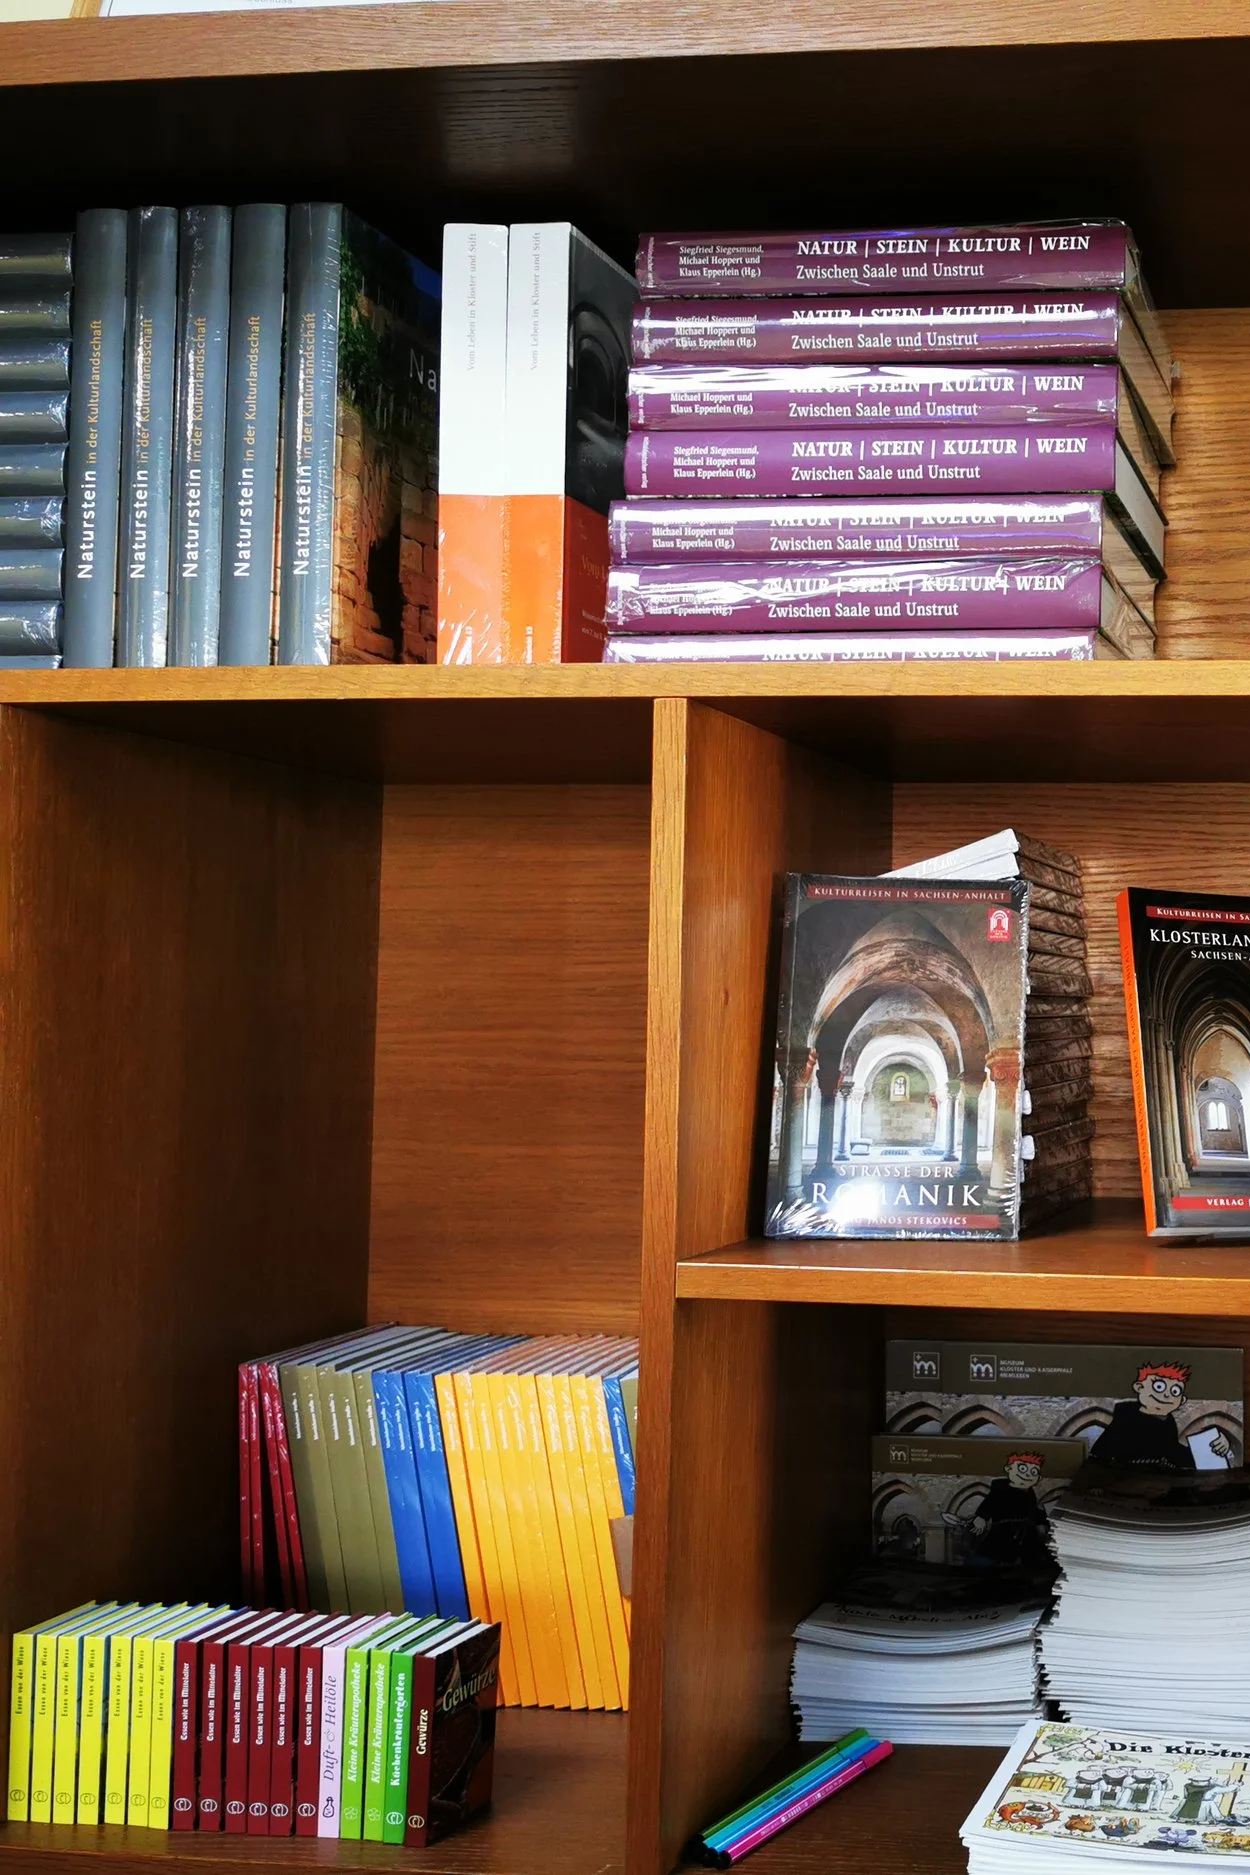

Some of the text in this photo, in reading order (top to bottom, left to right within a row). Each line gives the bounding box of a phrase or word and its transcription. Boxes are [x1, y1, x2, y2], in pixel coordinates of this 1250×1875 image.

[679, 245, 764, 255] Siegfried Siegesmund,
[797, 236, 1091, 255] NATUR STEIN KULTUR WEIN
[679, 255, 761, 266] Michael Hoppert und
[796, 262, 985, 279] Zwischen Saale und Unstrut
[679, 267, 761, 279] Klaus Epperlein (Hg.)
[466, 232, 477, 371] Vom Leben in Kloster und Stift
[303, 313, 316, 418] Kulturlandschaft
[302, 423, 313, 444] der
[78, 320, 102, 579] Naturstein in der Kulturlandschaft
[130, 319, 152, 578] Naturstein in der Kulturlandschaft
[183, 317, 207, 577] Naturstein in der Kulturlandschaft
[234, 316, 260, 577] Naturstein in der Kulturlandschaft
[673, 446, 709, 456] Siegfried
[791, 437, 1087, 457] NATUR STEIN KULTUR WEIN
[673, 457, 756, 468] Michael Hoppert und
[791, 464, 980, 481] Zwischen Saale und Unstrut
[673, 468, 756, 480] Klaus Epperlein (Hg.)
[293, 465, 311, 575] Naturstein
[814, 887, 891, 898] KULTURREISEN
[913, 891, 1006, 900] SACHSEN-ANHALT
[1156, 907, 1221, 920] KULTURREISEN
[1225, 912, 1235, 920] IN
[839, 1165, 954, 1178] STRASSE DER
[1206, 1198, 1244, 1206] VERLAG
[906, 1216, 968, 1226] STEKOVICS
[15, 1646, 25, 1715] Essen von der Wiese
[442, 1669, 495, 1712] Gewürze
[180, 1662, 190, 1741] Essen wie im Mittelalter
[324, 1675, 337, 1726] Heilöle
[347, 1662, 362, 1783] Kleine Kräuterapotheke
[370, 1663, 386, 1784] Kleine Kräuterapotheke
[390, 1672, 407, 1787] Küchenkräutergarten
[416, 1708, 429, 1755] Gewürze
[1106, 1741, 1153, 1754] Die
[322, 1744, 338, 1781] Duft-
